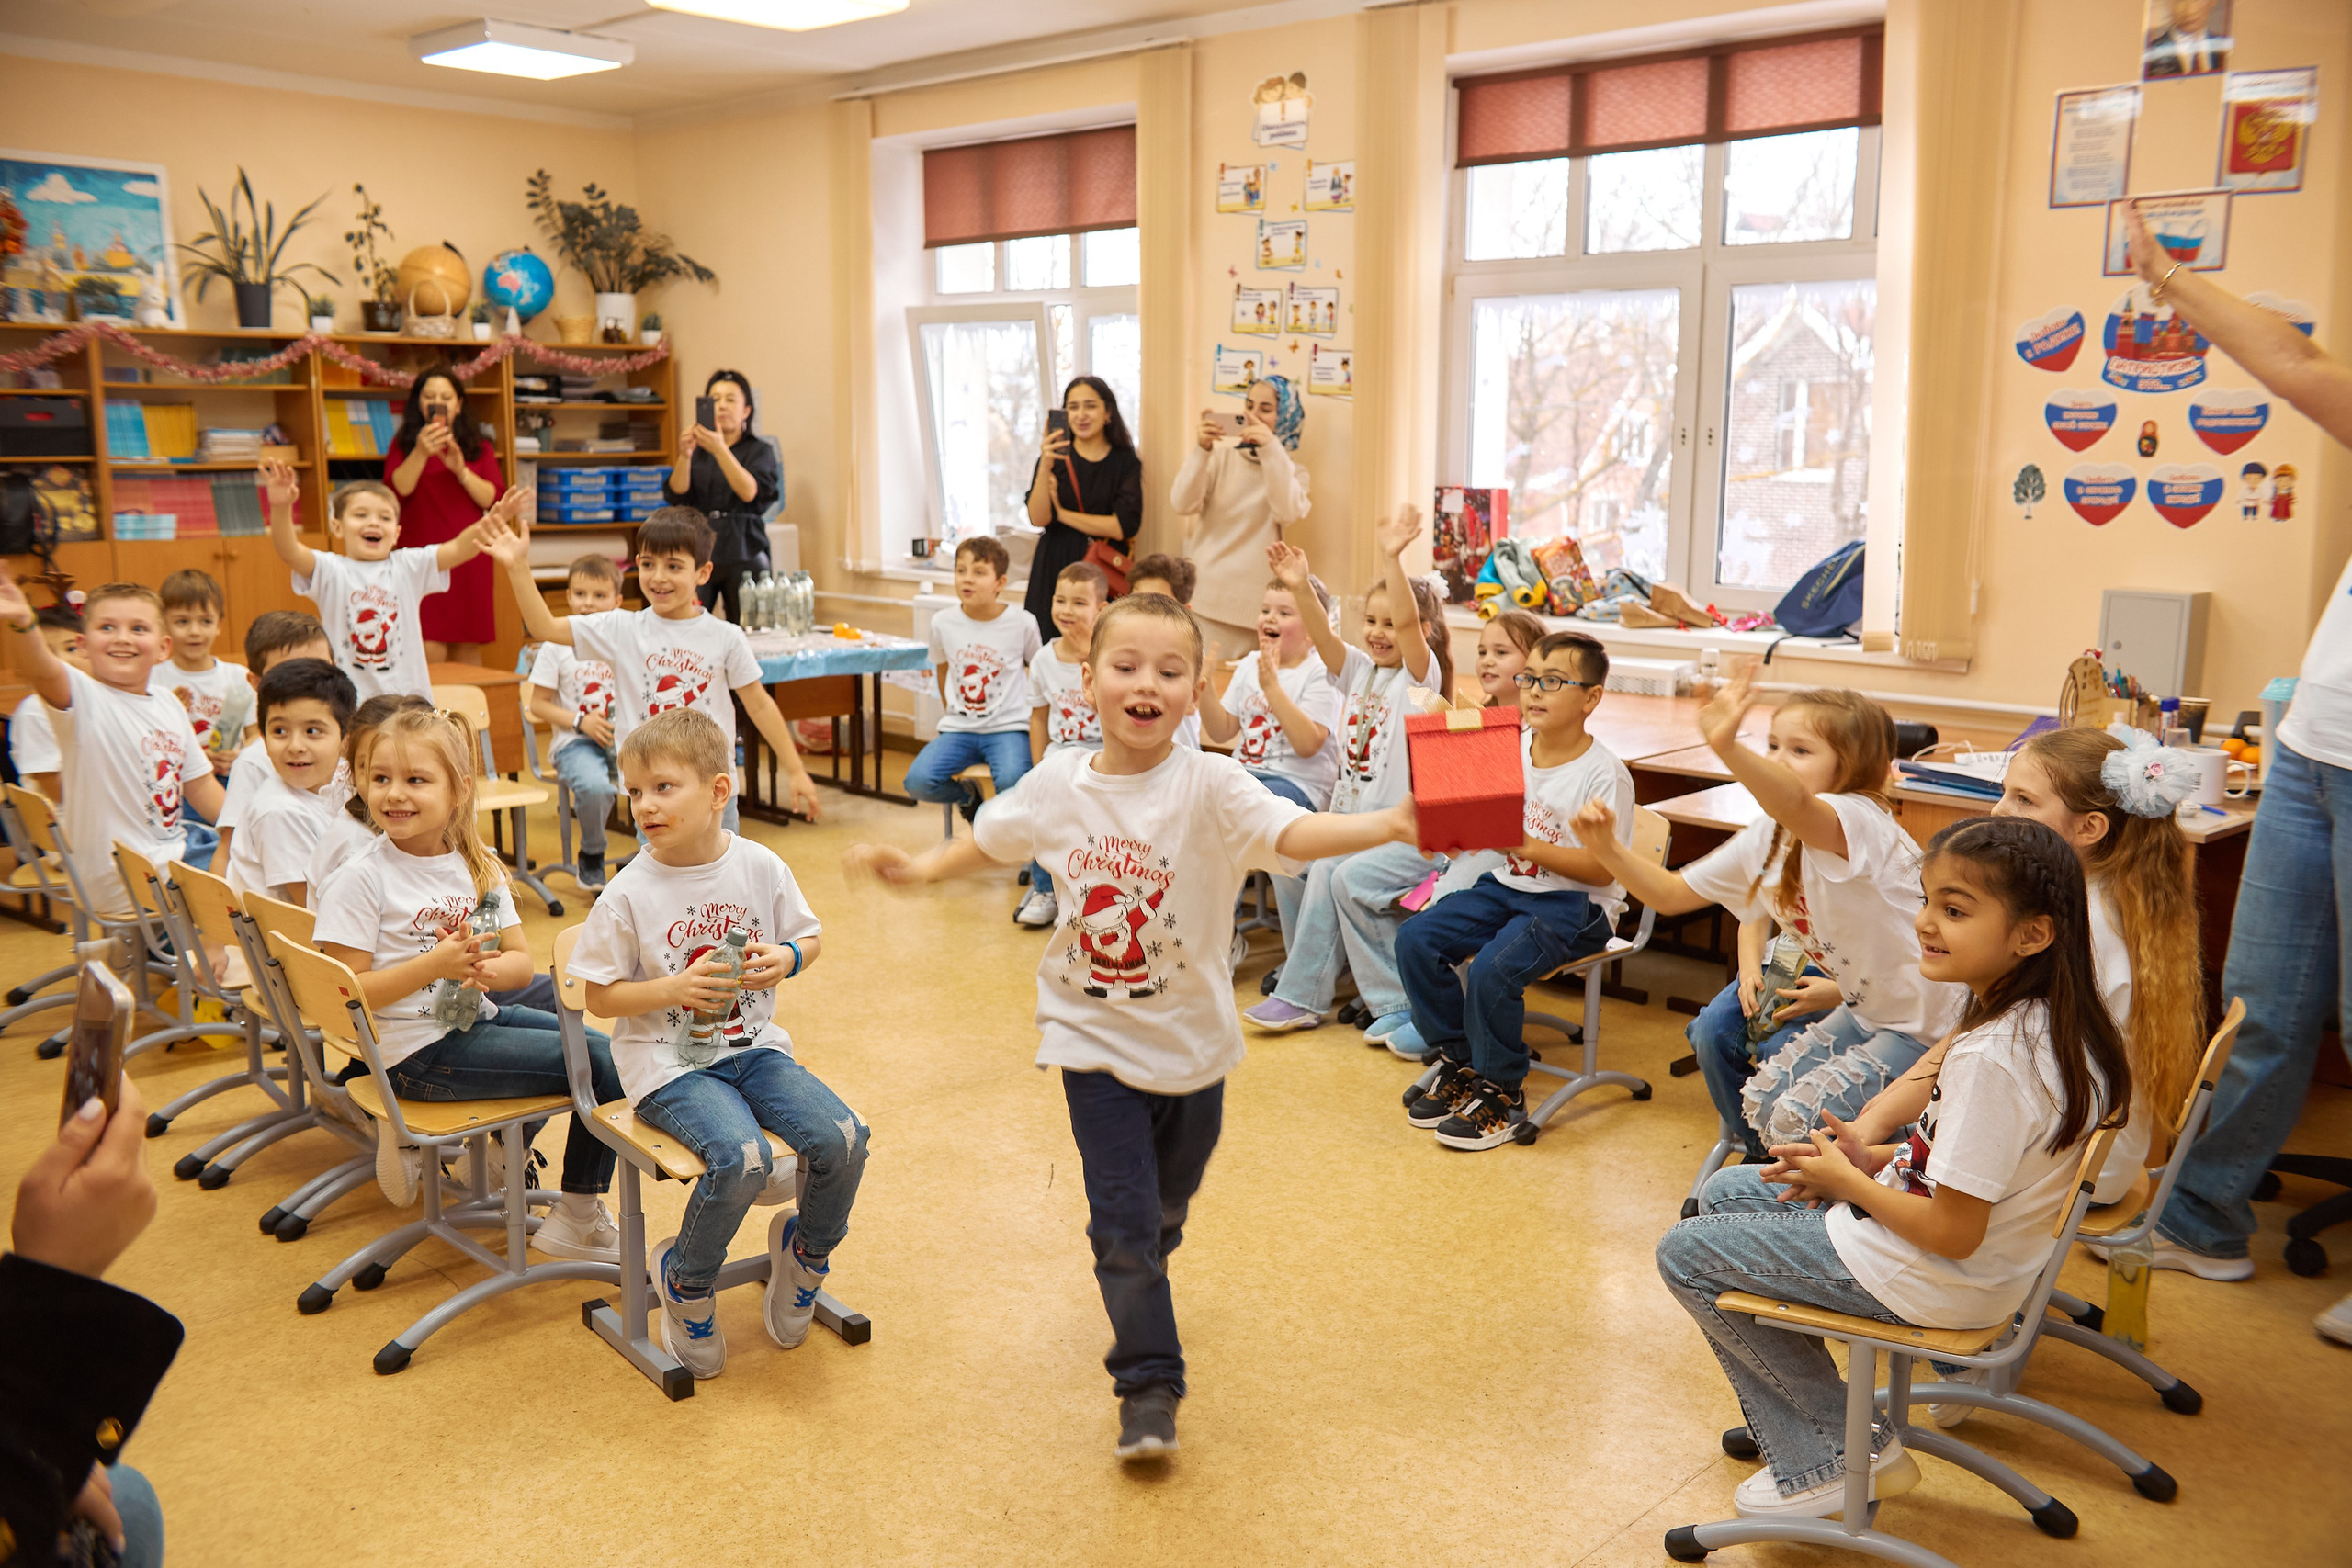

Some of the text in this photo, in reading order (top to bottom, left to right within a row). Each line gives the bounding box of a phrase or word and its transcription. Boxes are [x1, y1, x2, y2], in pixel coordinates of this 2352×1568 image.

[646, 653, 716, 682] Christmas
[1099, 835, 1152, 860] Merry
[1068, 848, 1175, 890] Christmas
[441, 895, 478, 908] Merr
[700, 903, 748, 921] Merry
[413, 906, 472, 931] Christ
[667, 915, 764, 949] Christas
